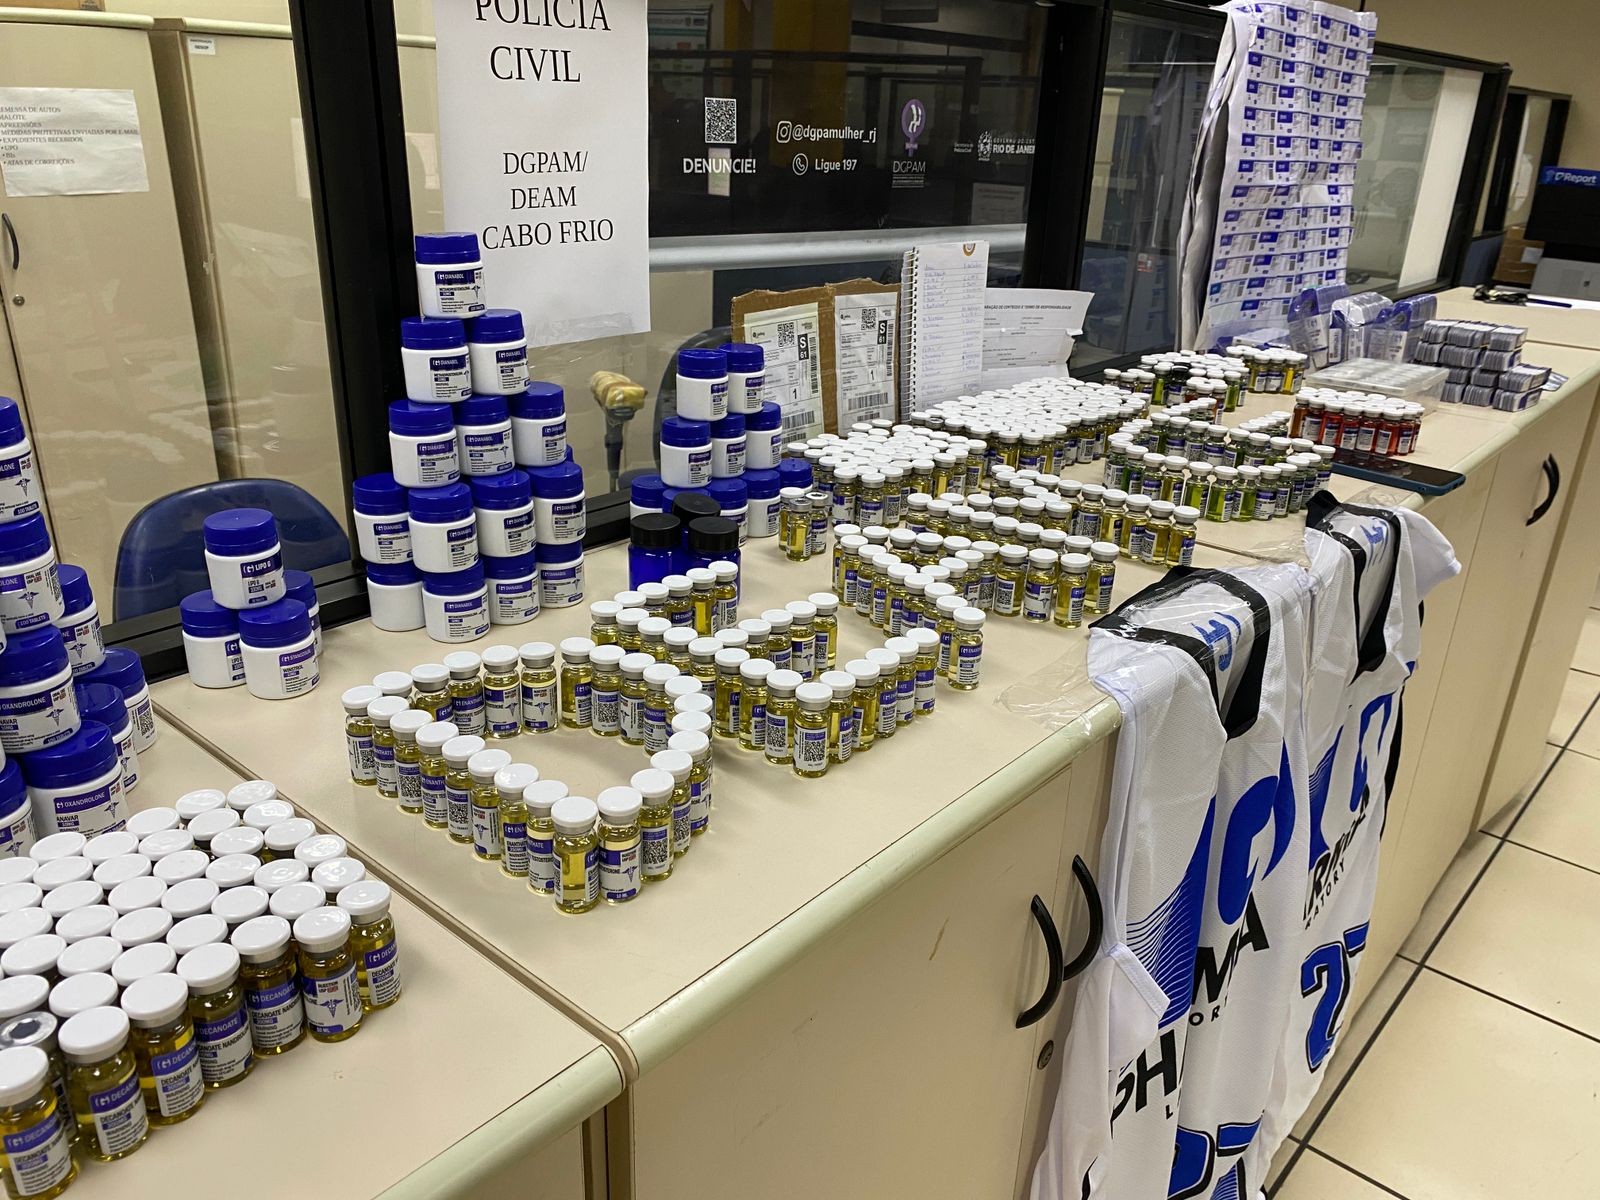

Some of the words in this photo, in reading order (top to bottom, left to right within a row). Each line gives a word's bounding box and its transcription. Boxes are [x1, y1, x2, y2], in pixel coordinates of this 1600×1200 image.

[490, 46, 581, 82] CIVIL
[792, 124, 877, 144] @dgpamulher_rj
[992, 144, 1005, 154] RIO
[1005, 145, 1015, 154] DE
[503, 151, 589, 174] DGPAM/
[683, 158, 757, 175] DENUNCIE!
[815, 158, 841, 173] Ligue
[842, 159, 858, 172] 197
[893, 160, 926, 173] DGPAM
[510, 186, 577, 209] DEAM
[482, 222, 552, 249] CABO
[559, 219, 614, 243] FRIO
[879, 322, 886, 333] S
[800, 336, 807, 348] S
[799, 351, 807, 359] 61
[870, 369, 875, 381] 1
[792, 388, 797, 400] 1
[255, 563, 267, 571] LIPO
[2, 696, 46, 710] OXANDROLONE
[64, 791, 105, 808] OXANDROLONE
[375, 977, 395, 989] WARNING
[260, 982, 295, 1002] DECANOATE
[252, 1009, 281, 1018] DECANOATE
[200, 1018, 238, 1035] DECANOATE
[161, 1068, 193, 1085] DECANOATE
